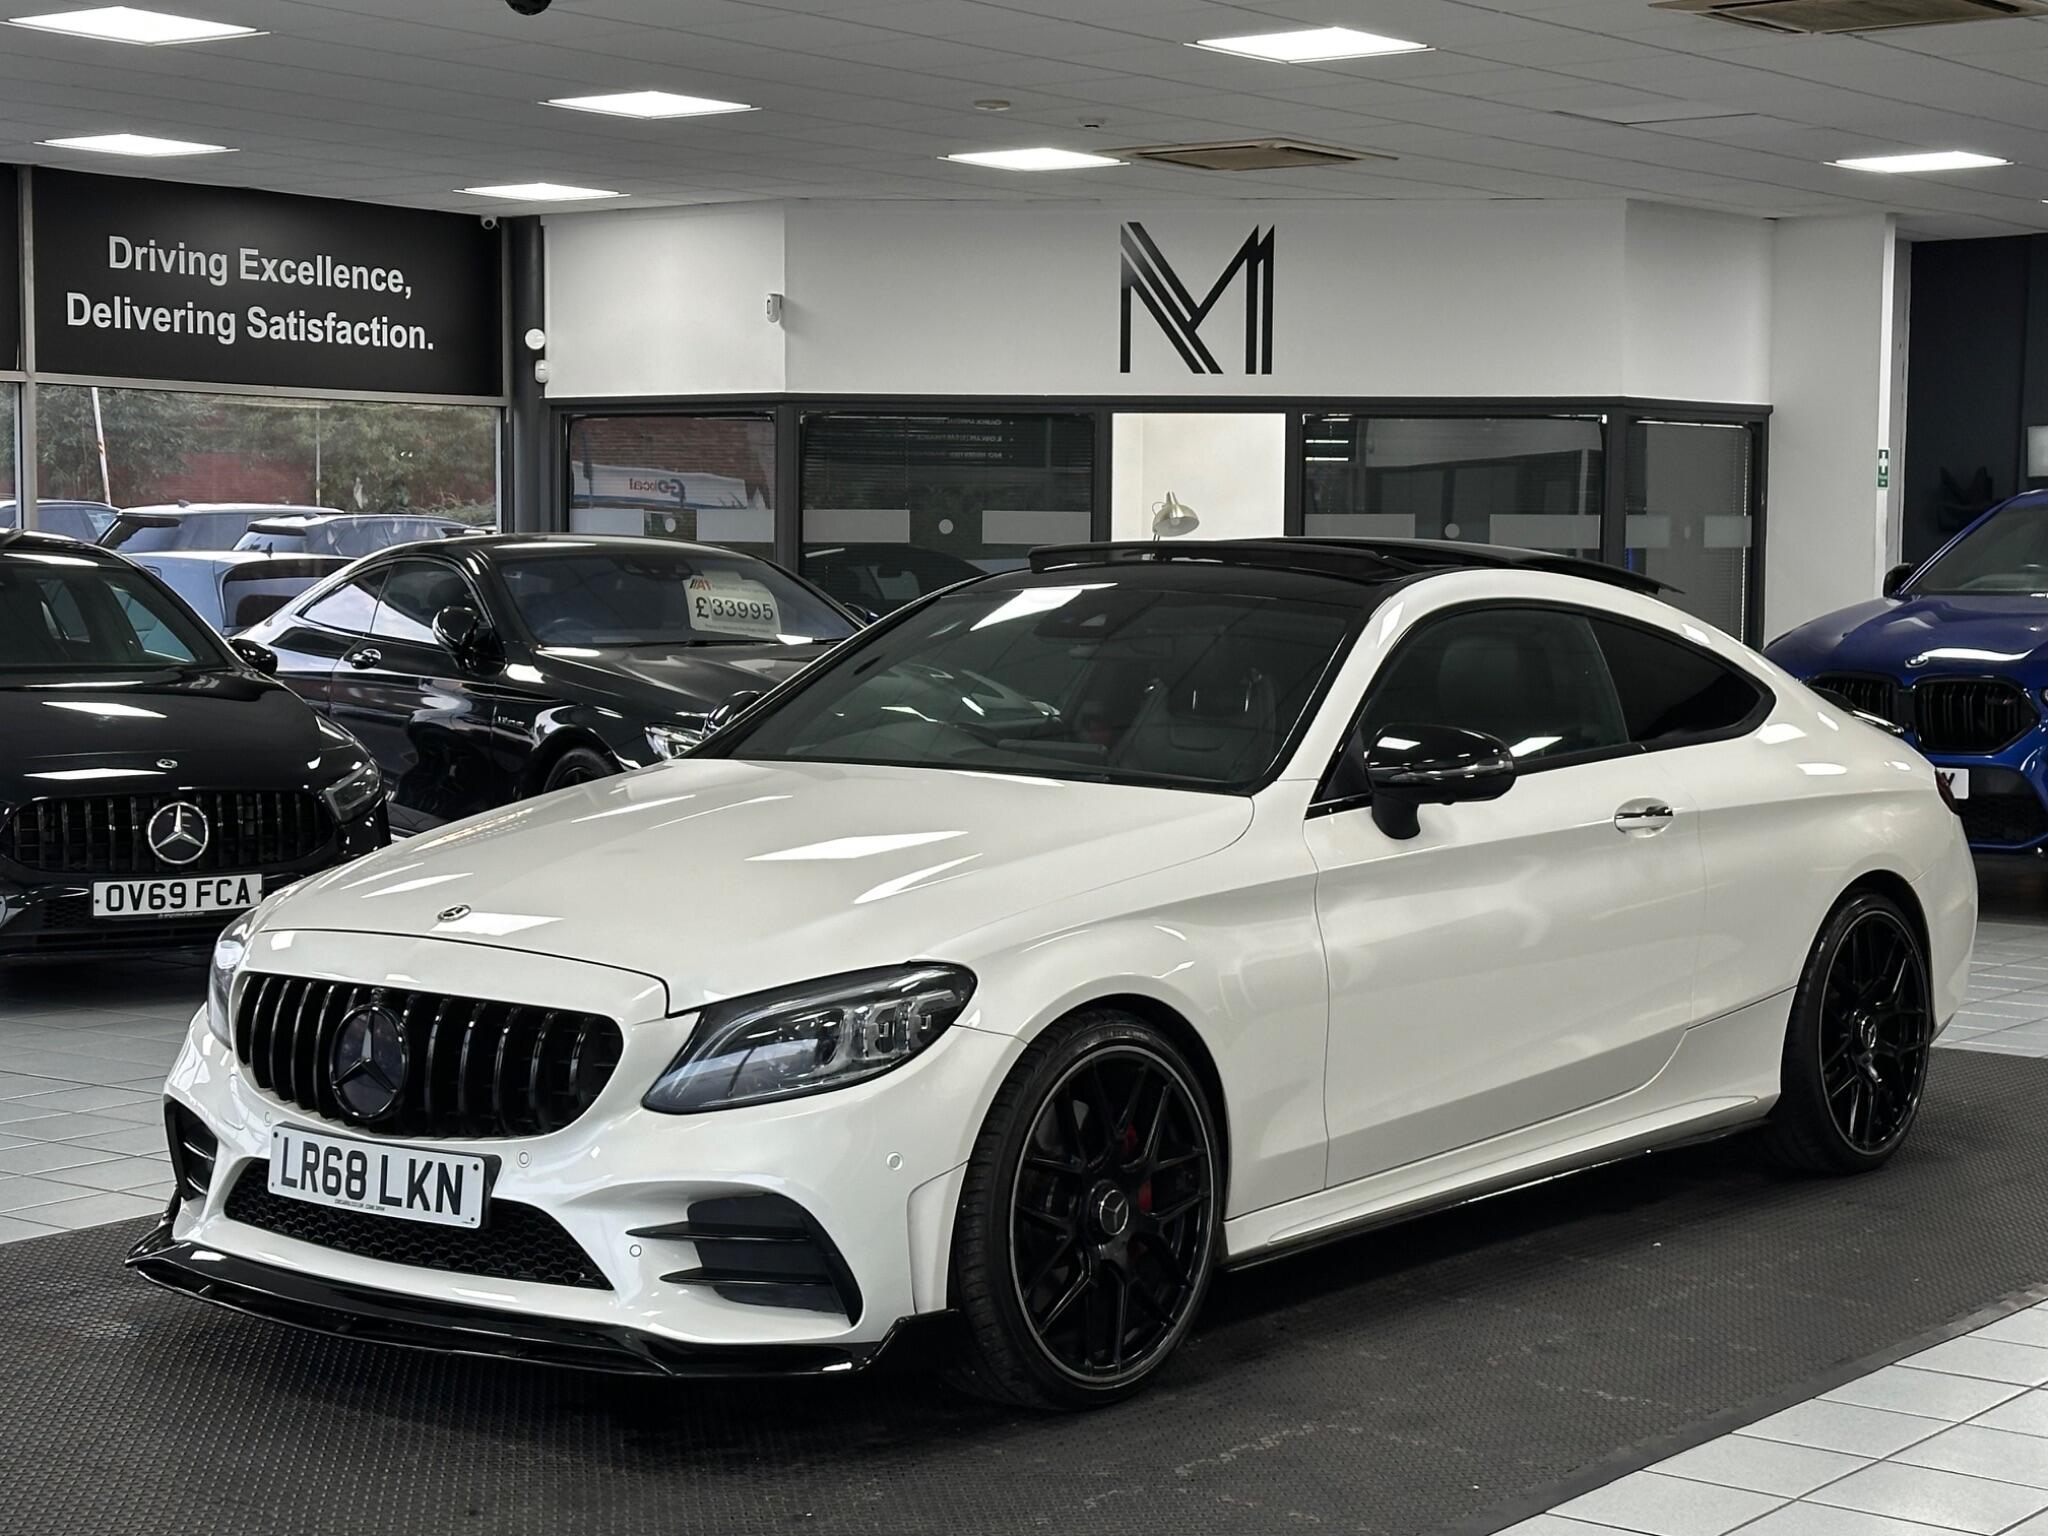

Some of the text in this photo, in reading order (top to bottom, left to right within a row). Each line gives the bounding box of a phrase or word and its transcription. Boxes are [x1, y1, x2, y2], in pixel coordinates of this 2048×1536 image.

[109, 235, 412, 299] Driving Excellence,
[66, 292, 434, 350] Delivering Satisfaction.
[695, 596, 774, 620] £33995
[106, 878, 251, 912] OV69 FCA
[281, 1137, 464, 1216] LR68 LKN
